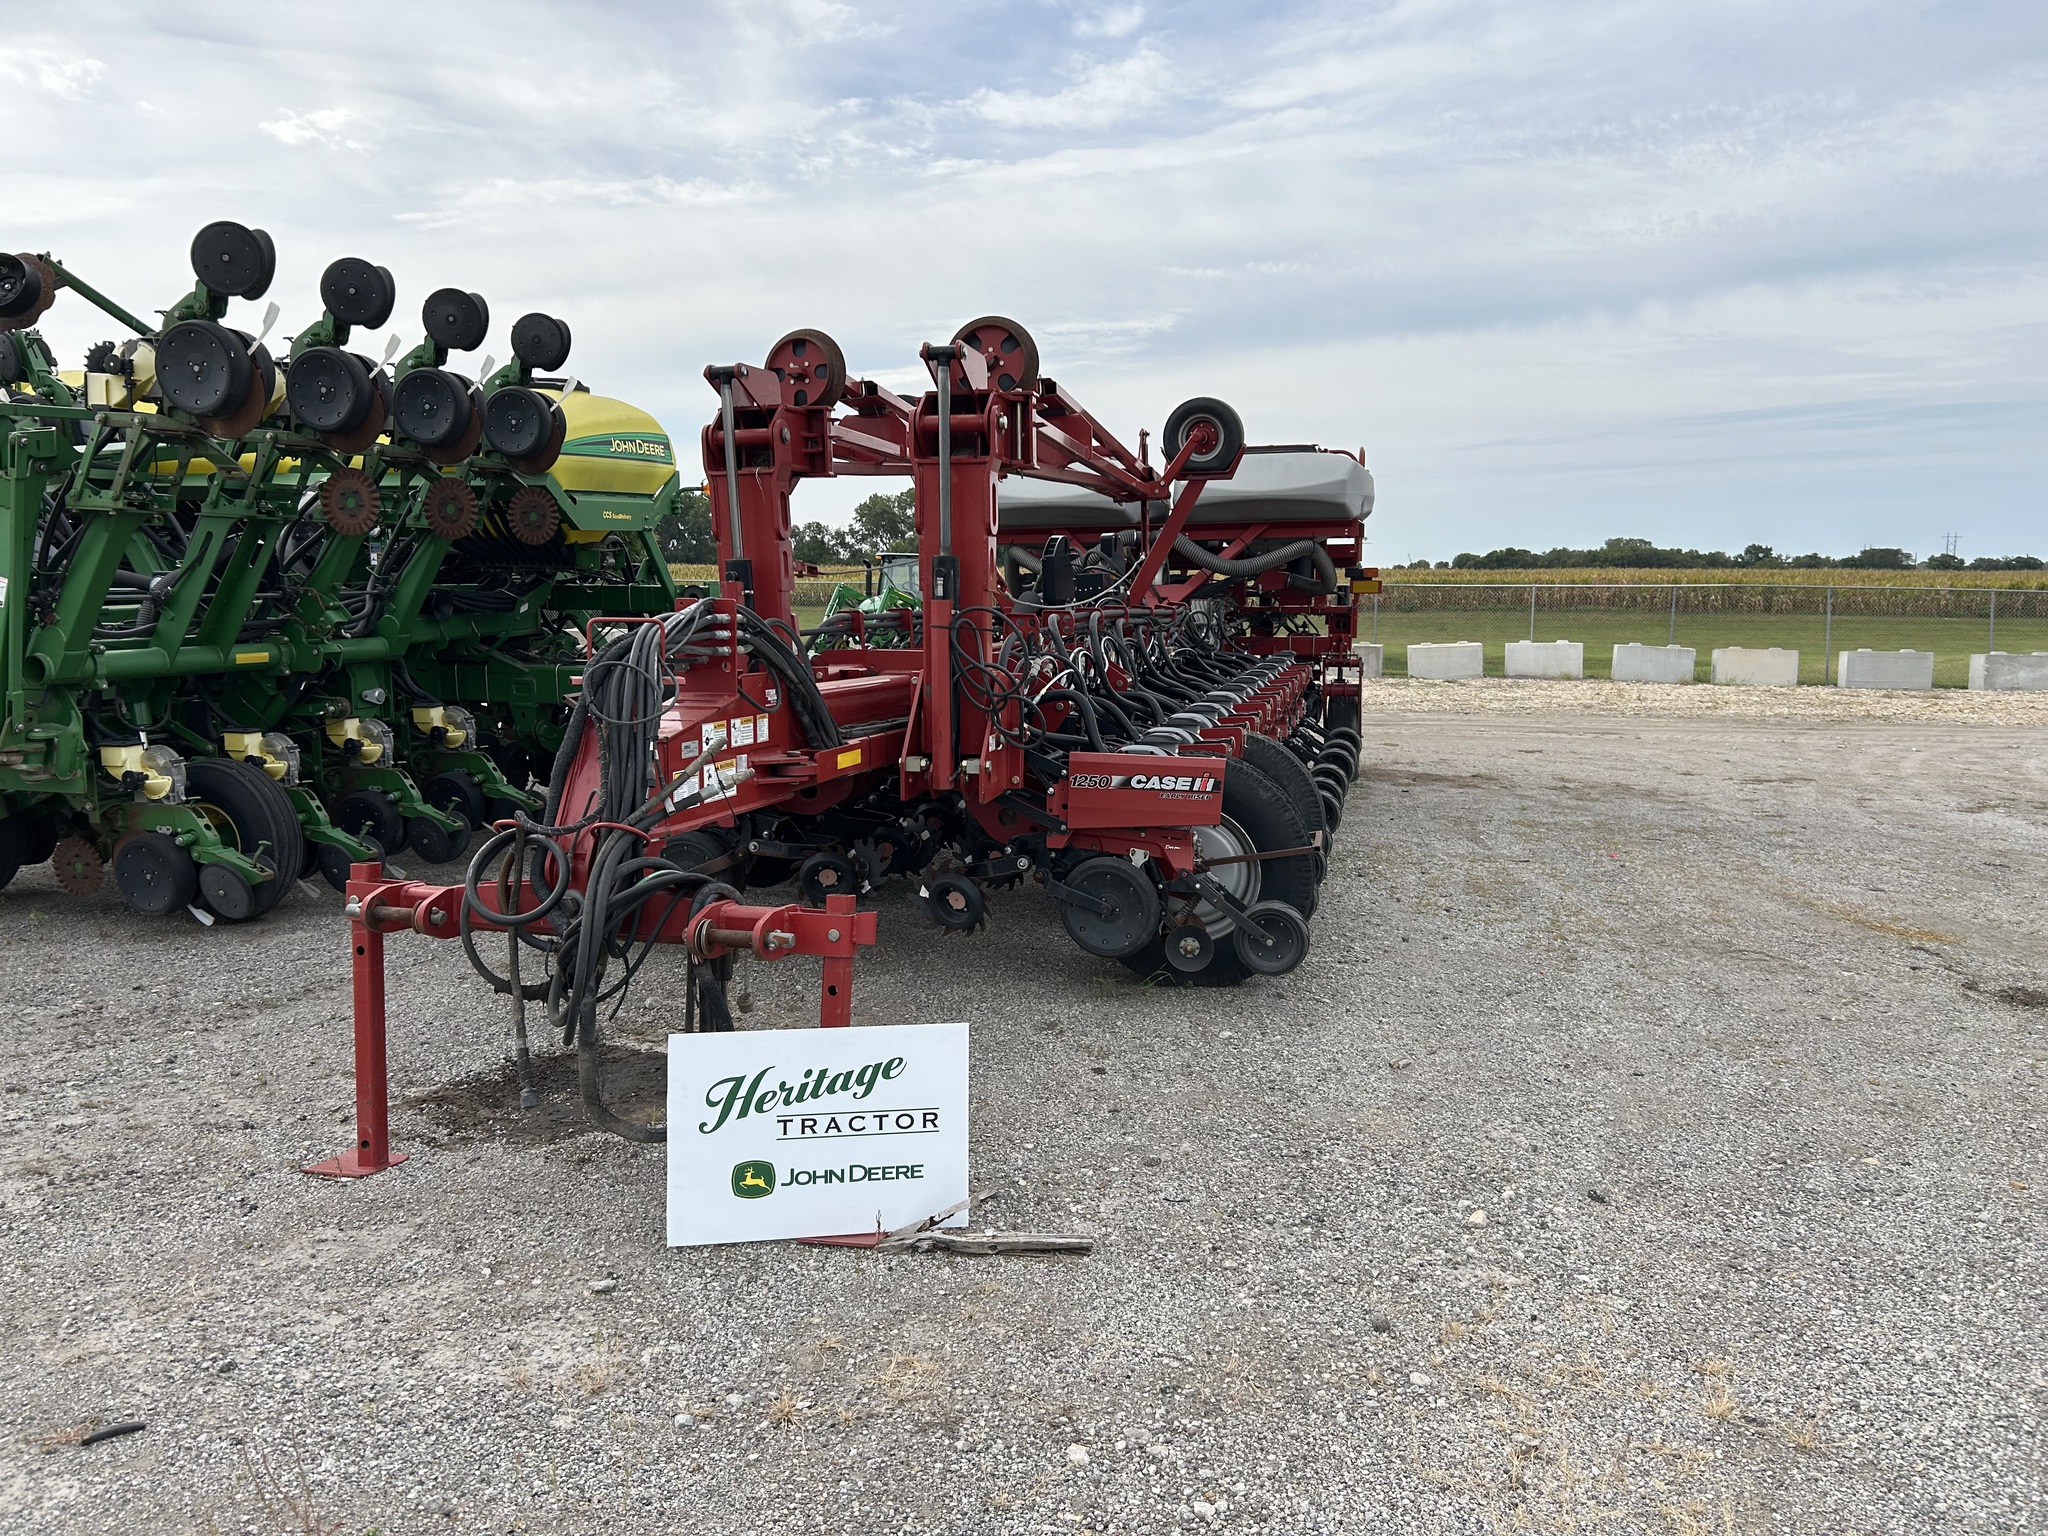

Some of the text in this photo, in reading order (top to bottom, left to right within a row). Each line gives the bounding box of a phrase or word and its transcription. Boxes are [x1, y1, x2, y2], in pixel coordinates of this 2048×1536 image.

[610, 437, 665, 456] JOHN DEERE
[1070, 774, 1111, 789] 1250
[1131, 775, 1192, 790] CASE
[1160, 792, 1212, 801] EARLY RISER
[699, 1056, 907, 1134] Heritage
[776, 1112, 939, 1136] TRACTOR
[781, 1164, 924, 1187] JOHN DEERE
